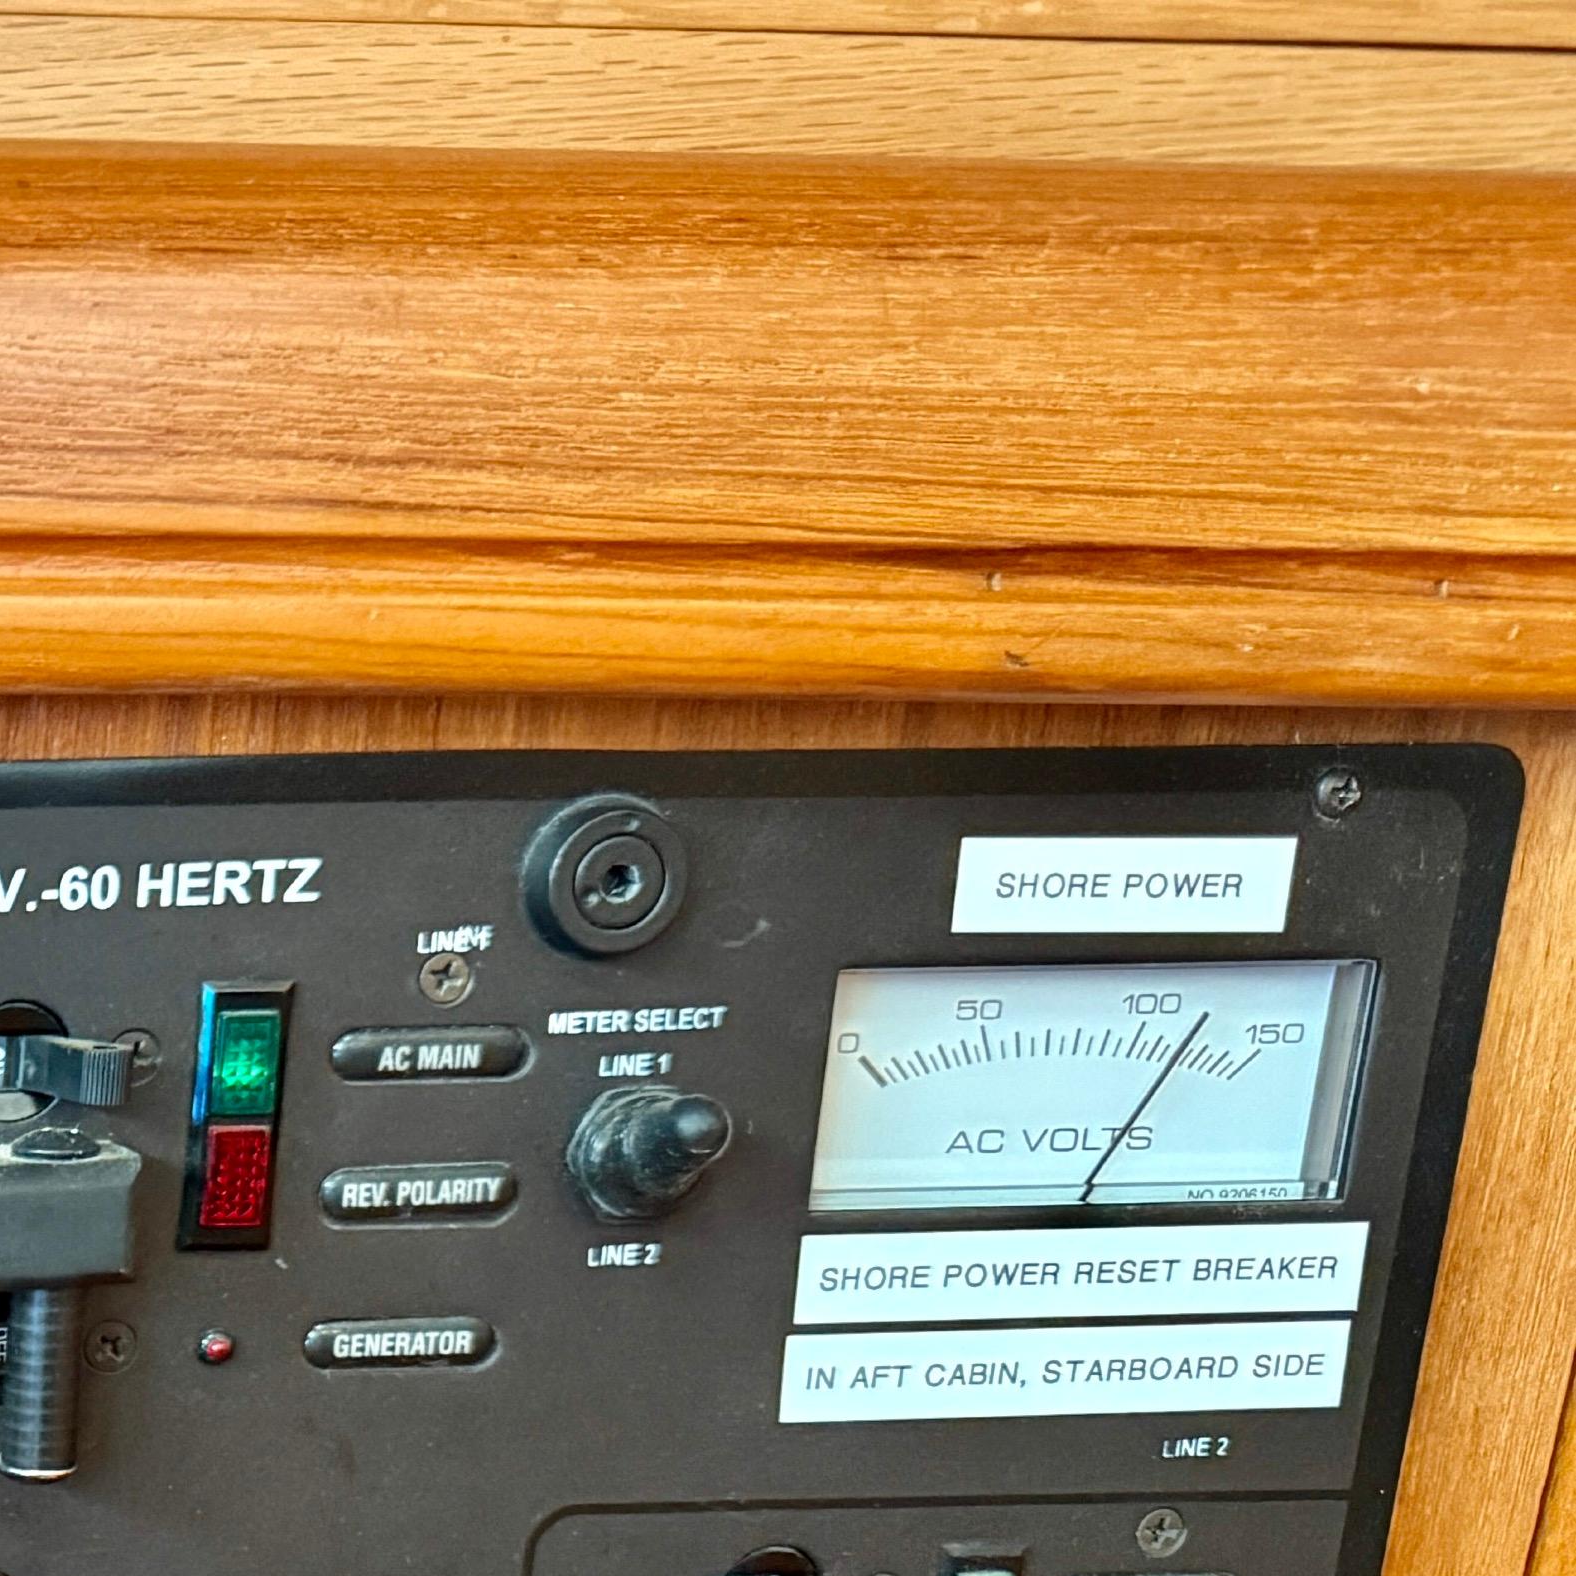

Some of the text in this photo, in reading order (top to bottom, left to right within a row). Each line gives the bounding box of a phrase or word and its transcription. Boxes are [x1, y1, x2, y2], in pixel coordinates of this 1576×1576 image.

[136, 858, 323, 907] HERTZ
[996, 873, 1242, 900] SHORE POWER
[956, 1000, 1002, 1020] 50
[1122, 993, 1181, 1014] 100
[548, 1007, 727, 1034] METER SELECT
[837, 1033, 860, 1053] 0
[1246, 1024, 1304, 1044] 150
[378, 1045, 480, 1071] AC MAIN
[599, 1053, 671, 1077] LINE 1
[946, 1126, 1153, 1153] AC VOLTS
[342, 1178, 503, 1208] REV. POLARITY
[588, 1243, 661, 1267] LINE 2
[820, 1256, 1338, 1292] SHORE POWER RESET BREAKER
[333, 1331, 473, 1358] GENERATOR
[806, 1354, 1325, 1390] IN AFT CABIN, STARBOARD SIDE
[1162, 1437, 1229, 1458] LINE 2
